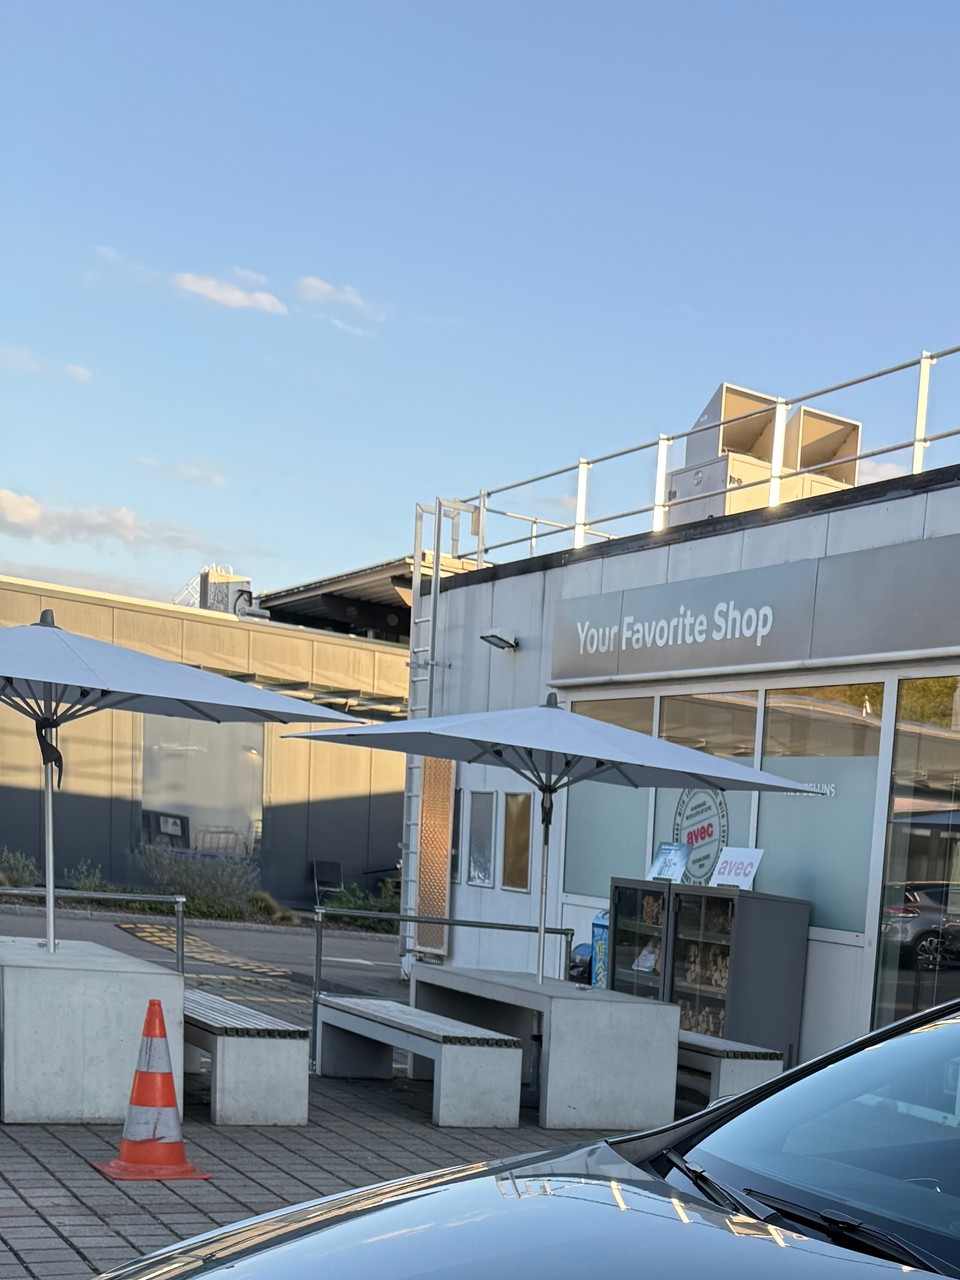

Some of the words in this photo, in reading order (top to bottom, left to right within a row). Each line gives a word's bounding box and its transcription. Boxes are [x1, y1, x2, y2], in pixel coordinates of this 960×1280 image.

[577, 621, 619, 654] Your
[621, 604, 707, 650] Favorite
[712, 600, 773, 646] Shop
[687, 822, 714, 845] avec
[717, 860, 754, 878] avec
